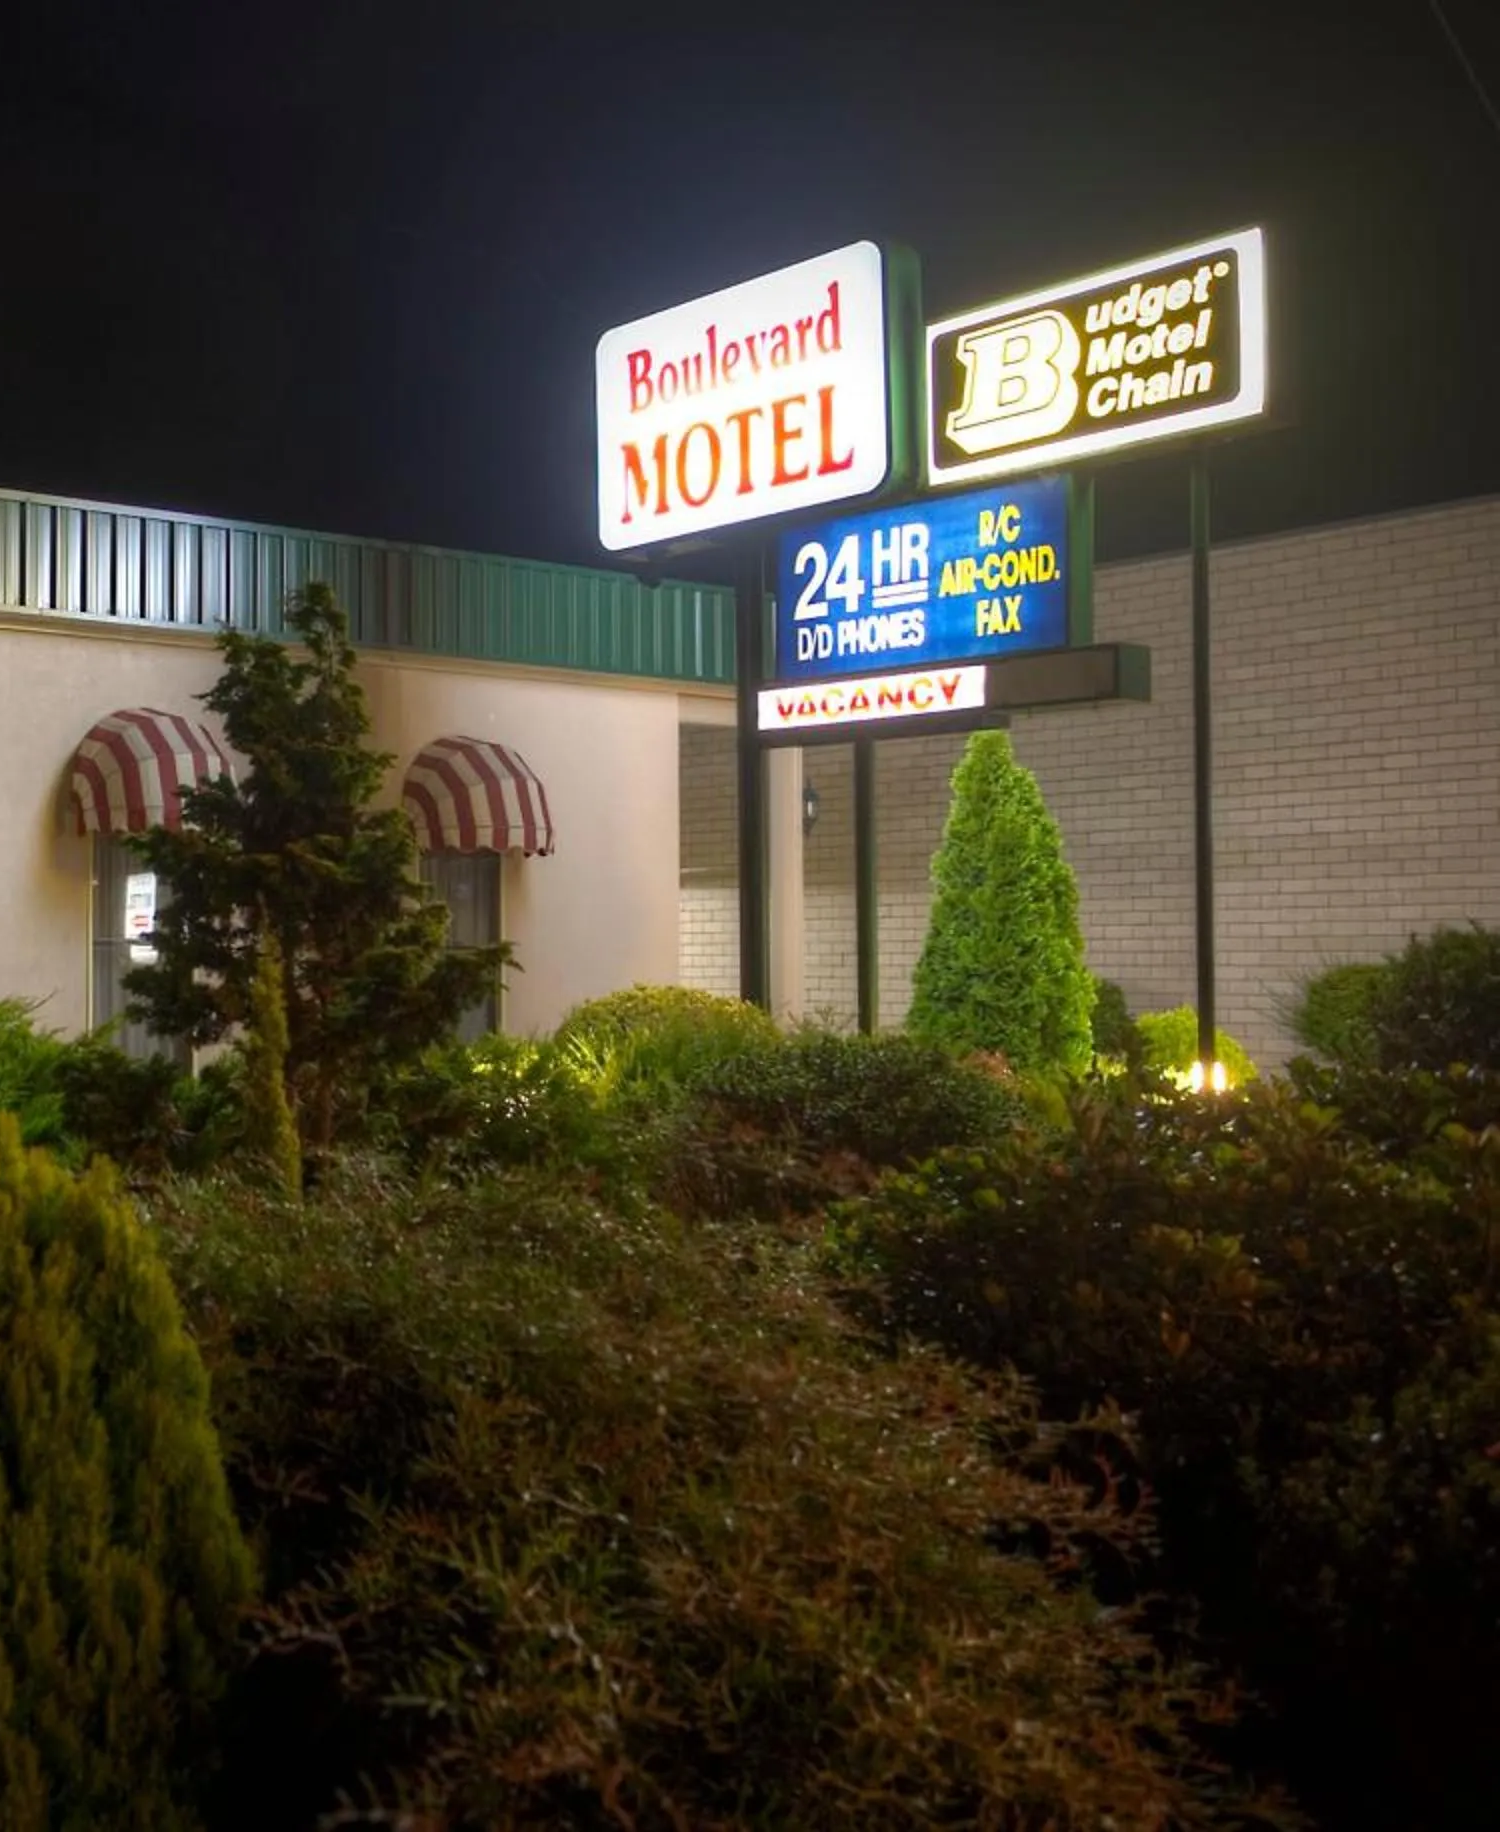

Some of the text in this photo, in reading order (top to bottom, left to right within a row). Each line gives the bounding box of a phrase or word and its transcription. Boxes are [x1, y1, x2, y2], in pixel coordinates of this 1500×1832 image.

[627, 280, 842, 414] Boulevard
[1086, 309, 1212, 376] Motel
[1086, 359, 1213, 418] Chain
[620, 384, 855, 524] MOTEL
[979, 504, 1021, 547] R/C
[794, 523, 930, 621] 24 HR
[938, 545, 1060, 597] AIR-COND.
[837, 609, 925, 655] PHONES
[976, 595, 1022, 637] FAX
[776, 673, 962, 720] VACANCY
